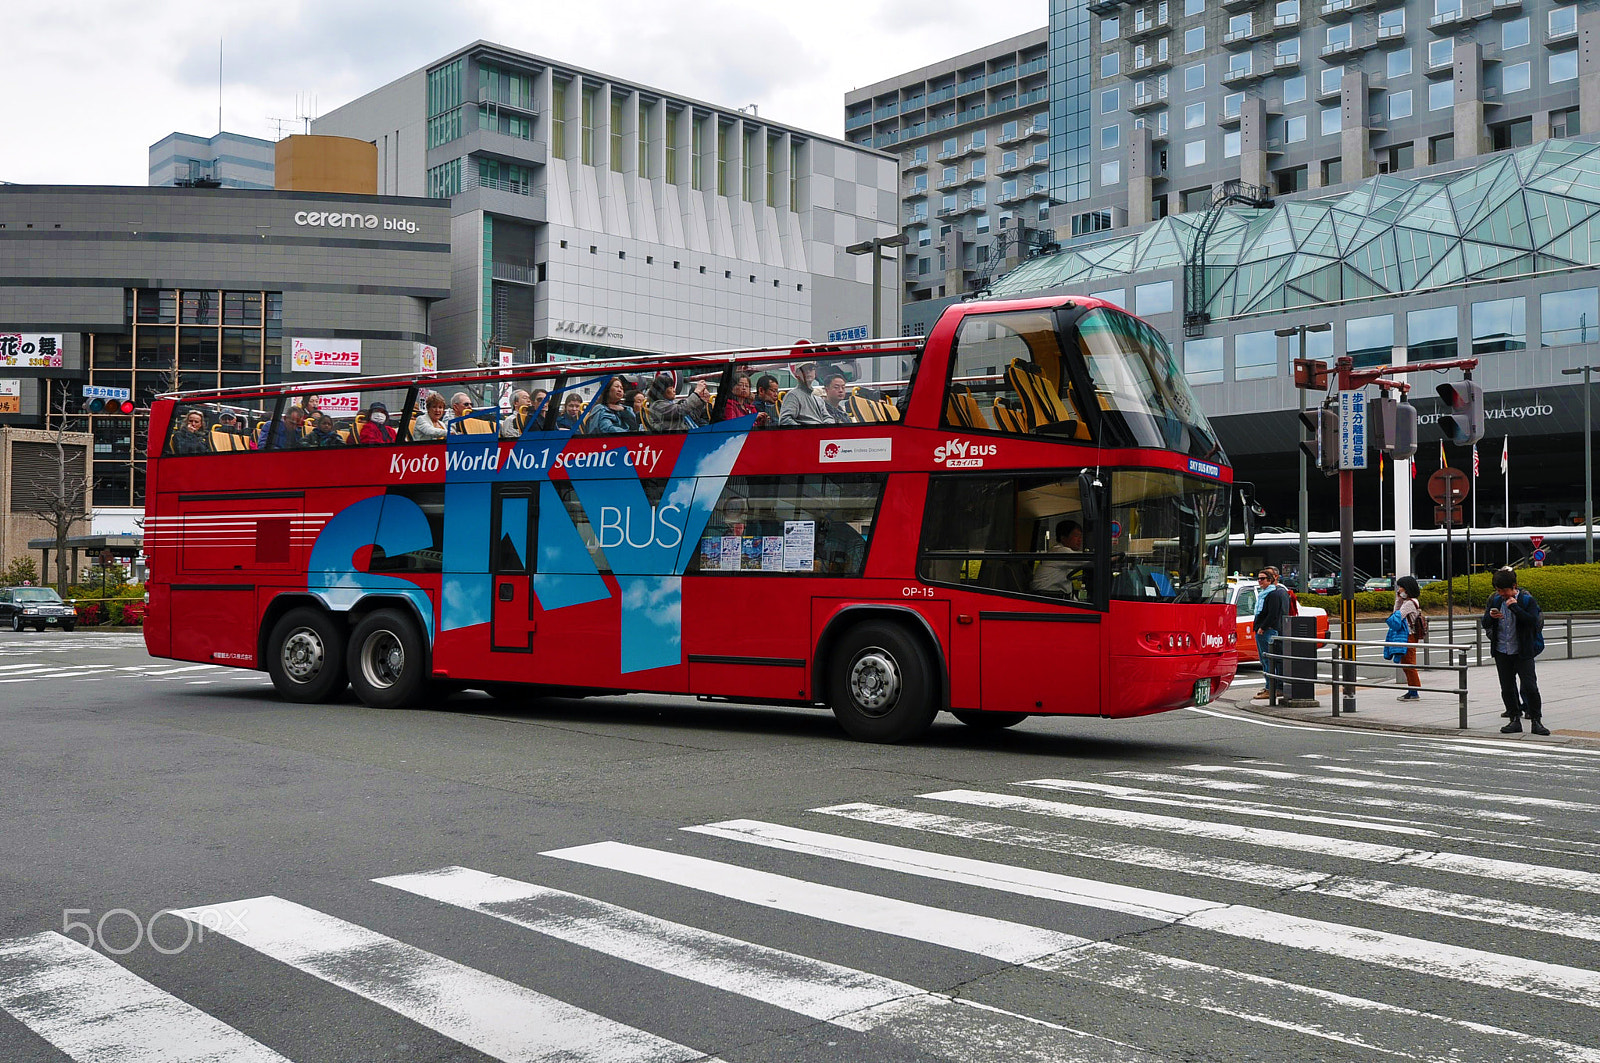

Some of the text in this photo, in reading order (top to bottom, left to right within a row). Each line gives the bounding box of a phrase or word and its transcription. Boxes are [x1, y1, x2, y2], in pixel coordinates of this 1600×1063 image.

[383, 217, 420, 234] bldg.
[0, 336, 57, 356] 花の舞
[314, 350, 360, 363] ジャンカラ
[1511, 405, 1553, 419] KYOTO
[1352, 392, 1364, 467] 歩車分離信号機
[933, 438, 998, 463] SKY BUS
[389, 442, 663, 480] Kyoto World No.1 scenic city
[1189, 460, 1218, 476] SKY BUS KYOTO
[600, 505, 682, 548] BUS
[902, 587, 934, 597] OP-15
[1206, 634, 1223, 648] Myojo
